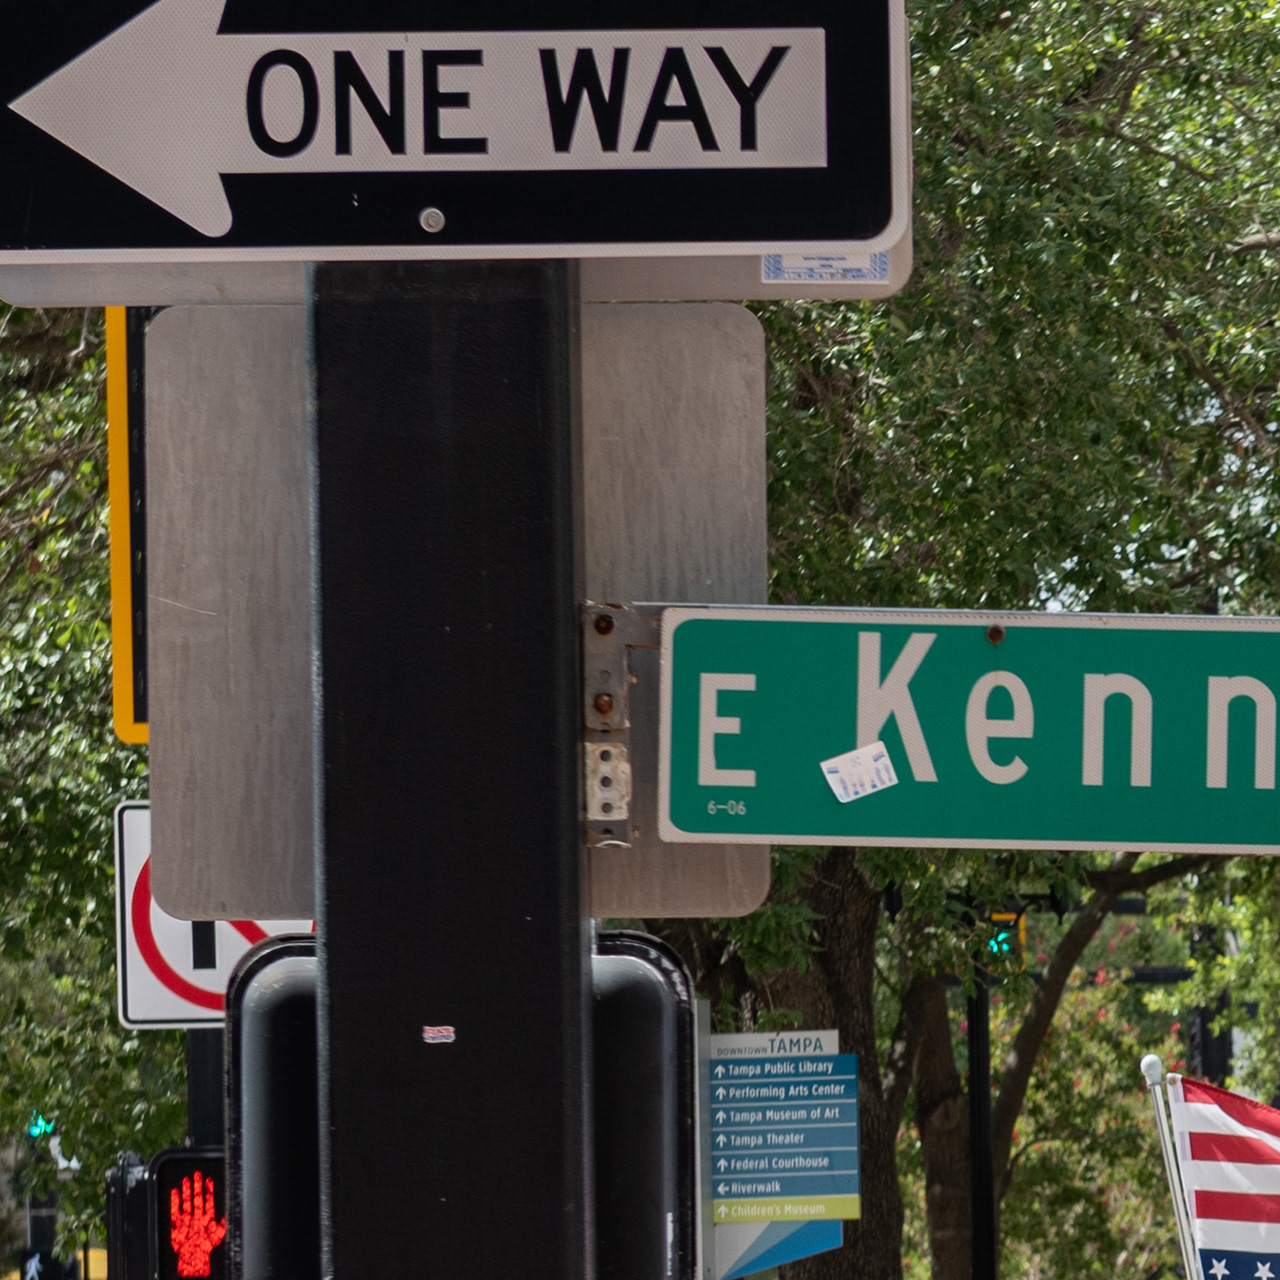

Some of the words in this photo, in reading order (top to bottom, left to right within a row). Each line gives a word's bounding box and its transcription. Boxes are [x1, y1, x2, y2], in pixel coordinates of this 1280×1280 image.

[246, 48, 489, 157] ONE
[540, 46, 791, 153] WAY
[698, 672, 757, 787] E
[707, 799, 747, 816] 6-06
[717, 1046, 768, 1056] DOWNTOWN
[769, 1037, 824, 1054] TAMPA
[728, 1064, 761, 1077] Tampa
[764, 1062, 796, 1075] Public
[799, 1060, 834, 1075] Library
[729, 1085, 786, 1100] Performing
[788, 1085, 809, 1097] Arts
[812, 1084, 846, 1096] Center
[730, 1111, 763, 1124] Tampa
[766, 1108, 807, 1121] Museum
[810, 1108, 822, 1119] of
[824, 1107, 840, 1119] Art
[730, 1134, 763, 1148] Tampa
[766, 1133, 805, 1146] Theater
[730, 1157, 769, 1171] Federal
[771, 1155, 830, 1169] Courthouse
[731, 1180, 782, 1194] Riverwalk
[731, 1204, 782, 1217] Children's
[784, 1203, 826, 1216] Museum
